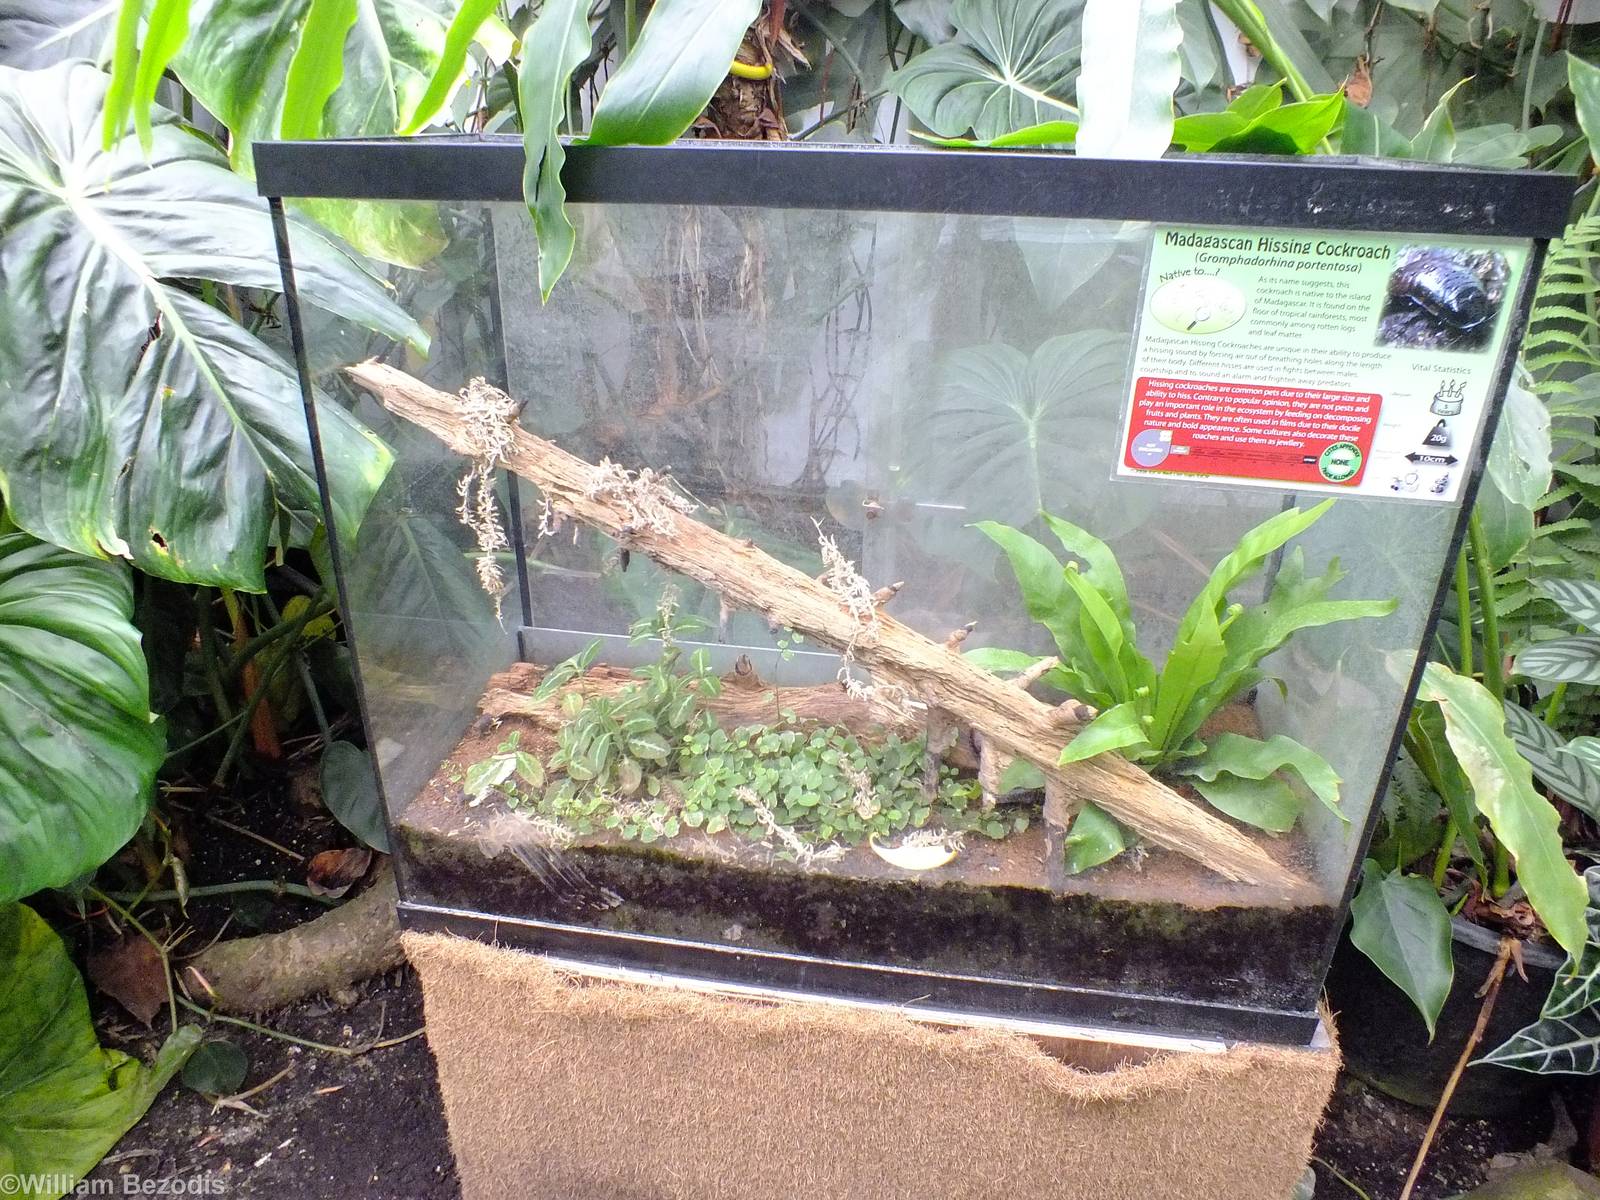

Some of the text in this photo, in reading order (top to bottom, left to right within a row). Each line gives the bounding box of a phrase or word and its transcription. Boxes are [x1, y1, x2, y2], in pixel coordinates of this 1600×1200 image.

[1165, 230, 1391, 260] Madagascan Hissing Cockroach
[1195, 252, 1362, 274] (Gromphadorhina portentosa)
[1160, 269, 1190, 283] Native
[1256, 287, 1293, 296] cockroach
[1302, 290, 1324, 298] native
[1348, 292, 1371, 301] island
[1323, 301, 1346, 310] found
[1279, 309, 1307, 318] tropical
[1250, 319, 1288, 329] commonly
[1290, 322, 1315, 331] among
[1340, 324, 1356, 334] logs
[1264, 328, 1278, 337] leaf
[1145, 335, 1189, 345] Madagascan
[1190, 338, 1216, 349] Hissing
[1361, 351, 1392, 359] produce
[1198, 349, 1207, 358] by
[1324, 358, 1344, 368] along
[1359, 360, 1383, 370] length
[1412, 363, 1472, 374] Vital Statistics
[1148, 379, 1174, 390] Hissing
[1175, 382, 1218, 392] cockroaches
[1280, 389, 1295, 397] due
[1304, 391, 1322, 399] their
[1322, 392, 1341, 402] large
[1341, 394, 1355, 402] size
[1145, 389, 1167, 400] ability
[1193, 392, 1224, 404] Contrary
[1233, 397, 1261, 405] popular
[1292, 400, 1308, 410] they
[1139, 398, 1154, 408] play
[1165, 400, 1201, 410] important
[1237, 407, 1274, 416] ecosystem
[1274, 408, 1283, 418] by
[1284, 409, 1312, 420] feeding
[1324, 412, 1371, 424] decomposing
[1145, 409, 1164, 417] fruits
[1204, 413, 1220, 423] They
[1233, 415, 1252, 424] often
[1280, 418, 1296, 427] films
[1297, 420, 1311, 428] due
[1321, 422, 1338, 430] their
[1338, 423, 1361, 432] docile
[1182, 421, 1198, 429] bold
[1242, 426, 1262, 434] Some
[1263, 428, 1291, 437] cultures
[1292, 430, 1306, 438] also
[1307, 431, 1338, 440] decorate
[1339, 434, 1359, 442] these
[1192, 433, 1219, 441] roaches
[1248, 436, 1268, 444] them
[1430, 434, 1447, 443] 20g
[1418, 454, 1446, 464] 10cm
